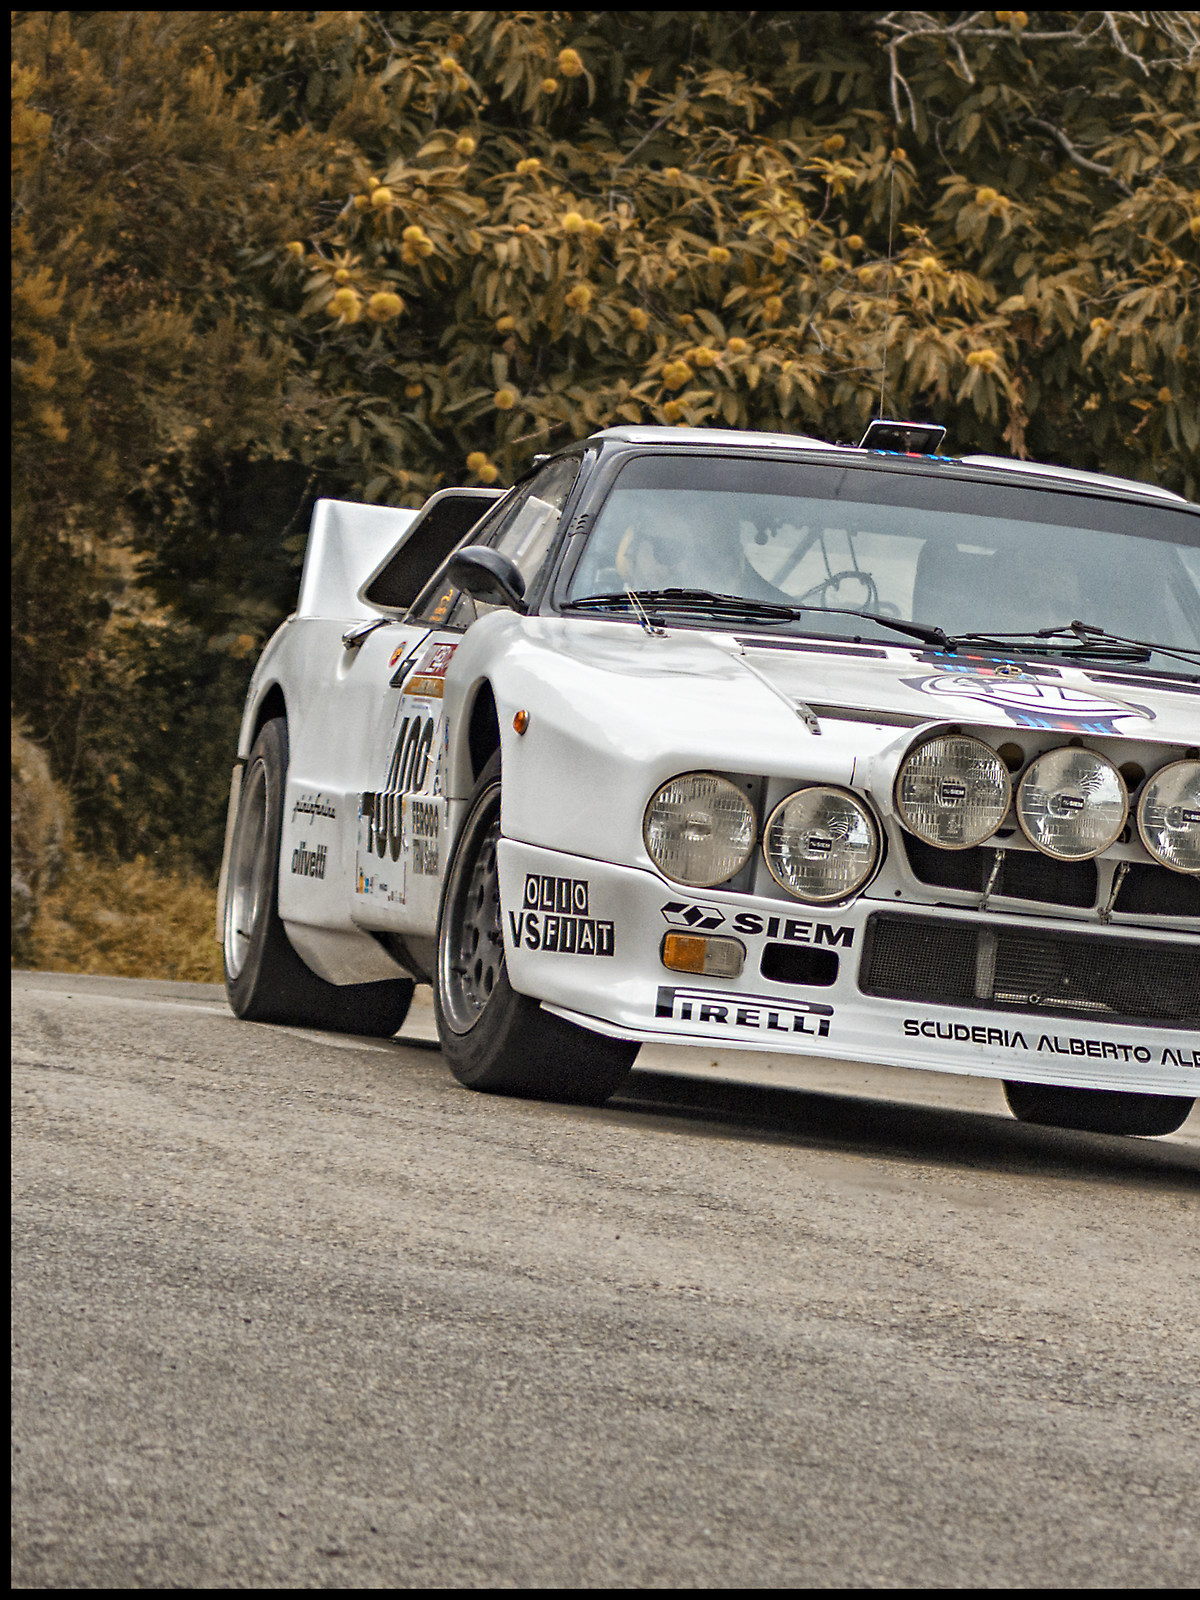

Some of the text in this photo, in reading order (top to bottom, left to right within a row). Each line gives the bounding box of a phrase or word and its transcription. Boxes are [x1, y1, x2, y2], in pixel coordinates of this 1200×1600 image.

[291, 840, 328, 880] olivetti
[524, 875, 588, 914] OLIO
[731, 912, 856, 948] SIEM
[655, 986, 834, 1038] PIRELLI
[903, 1019, 1029, 1050] SCUDERIA
[1037, 1036, 1152, 1064] ALBERTO
